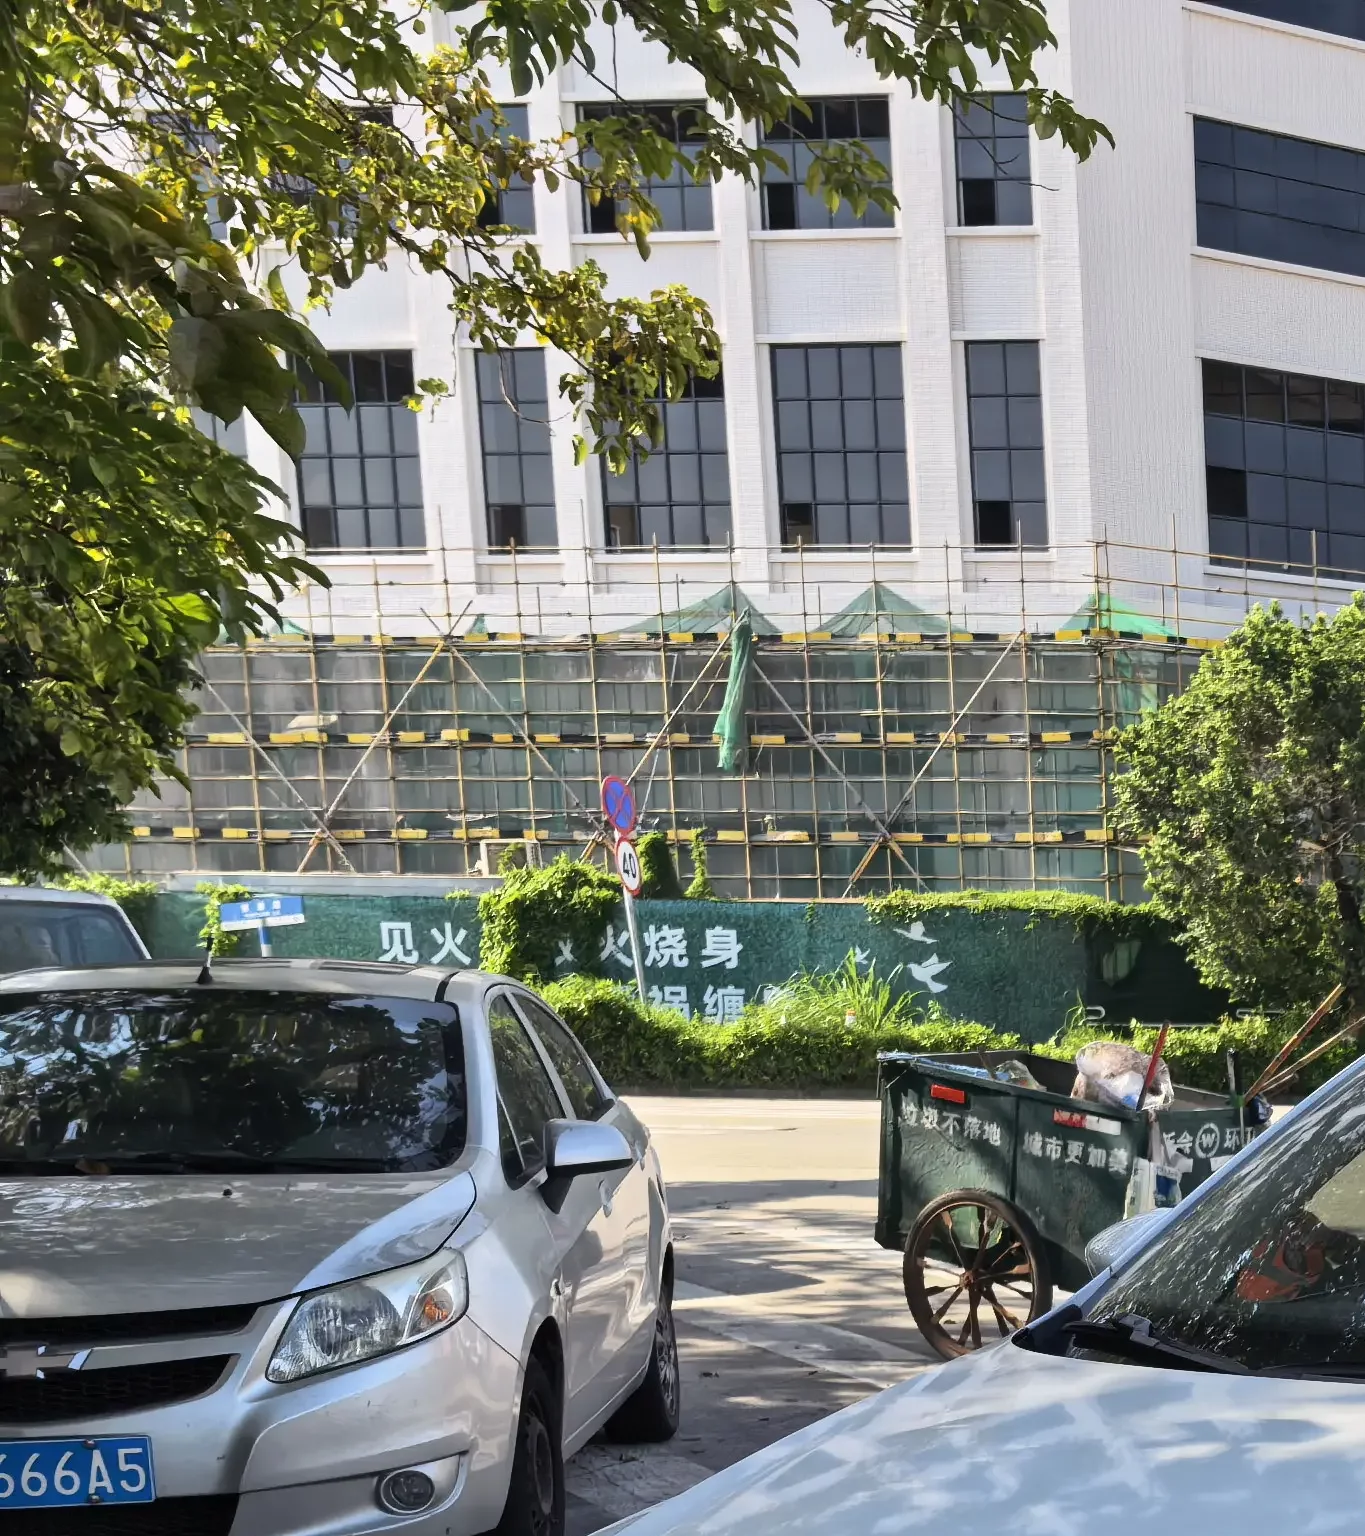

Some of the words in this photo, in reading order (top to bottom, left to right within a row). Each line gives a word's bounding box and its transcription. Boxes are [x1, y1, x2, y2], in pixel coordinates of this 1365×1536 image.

[622, 851, 637, 878] 40
[378, 921, 743, 969] 见火火烧身
